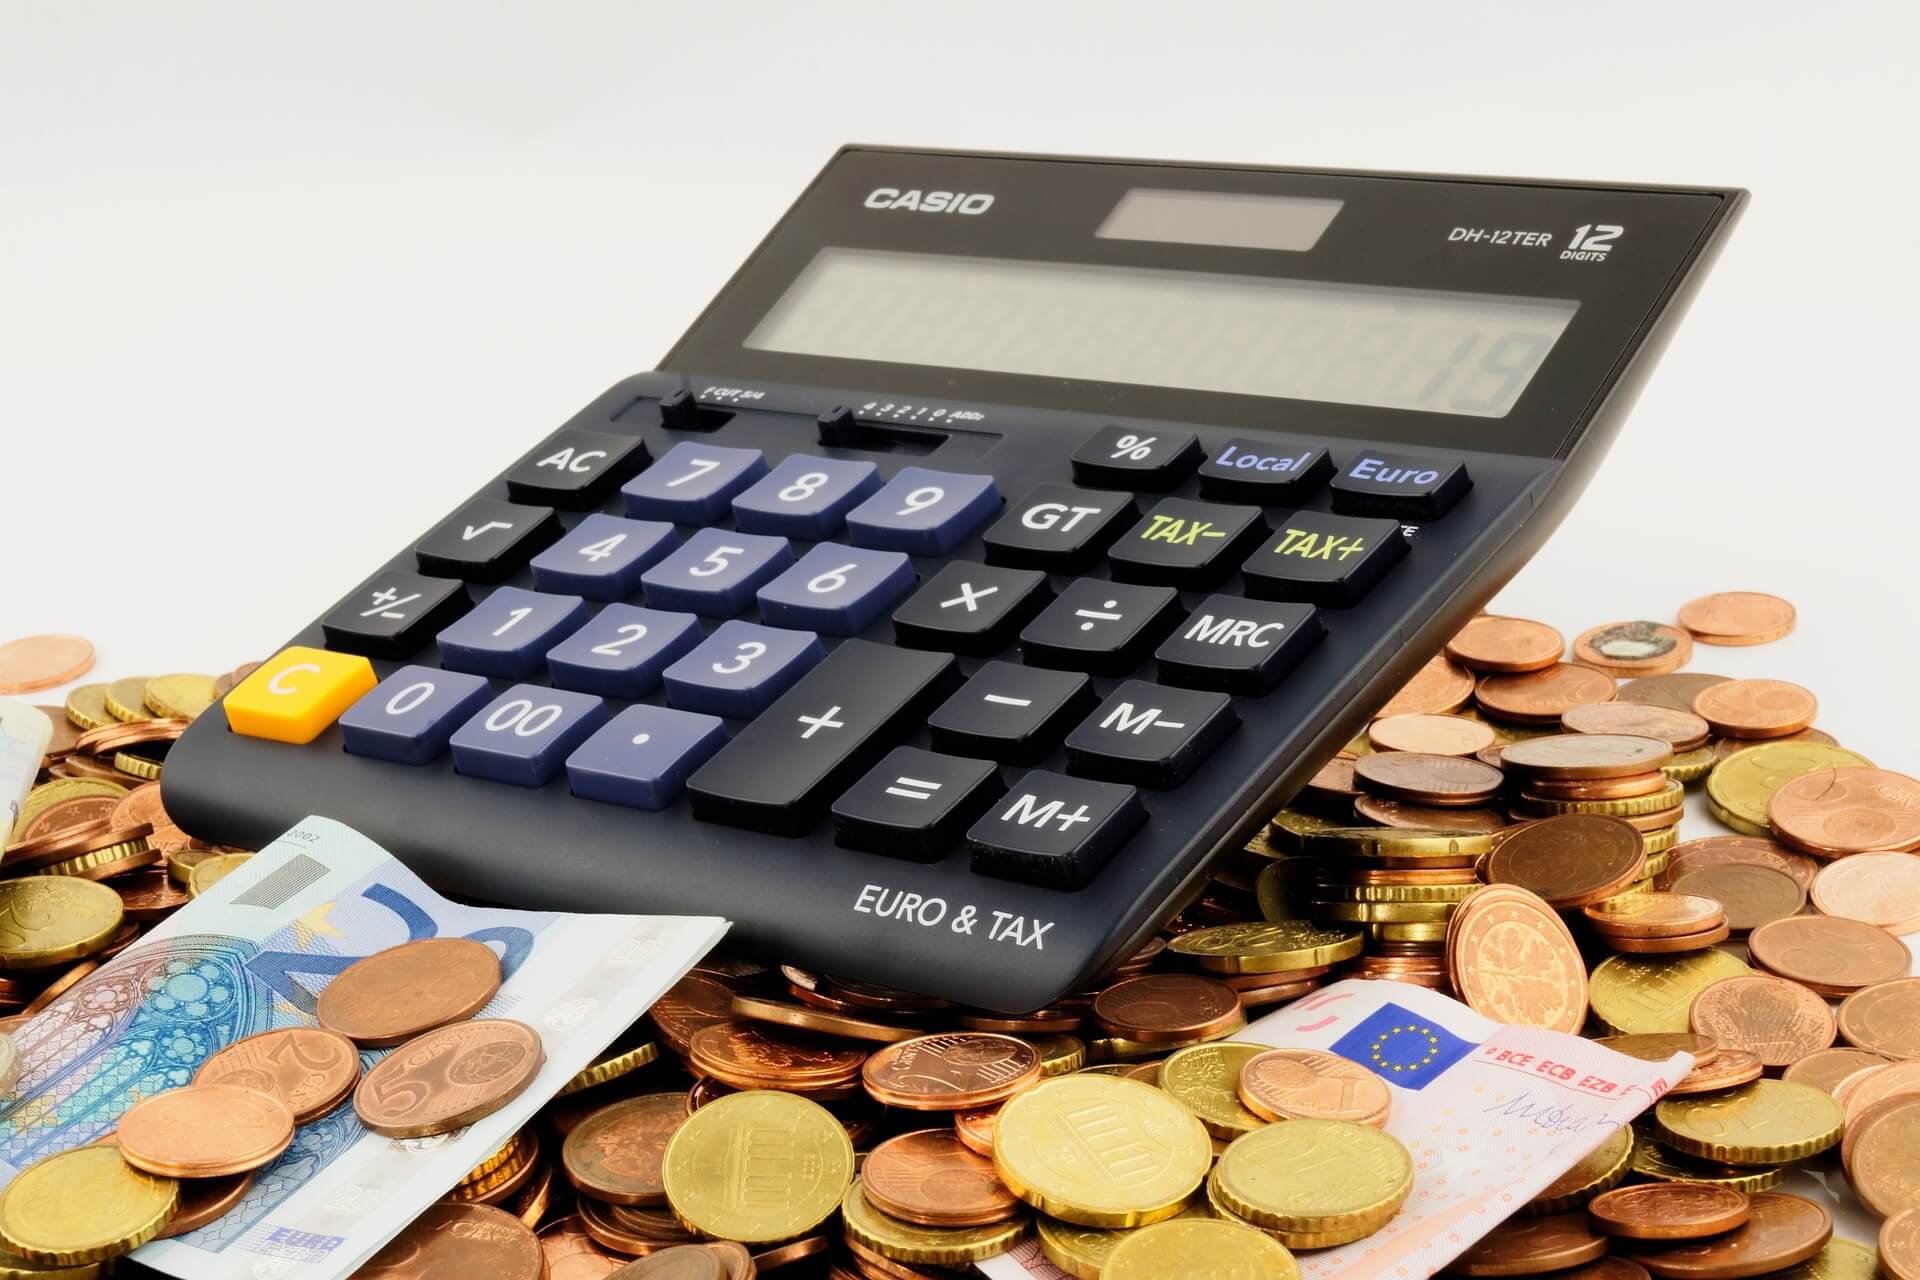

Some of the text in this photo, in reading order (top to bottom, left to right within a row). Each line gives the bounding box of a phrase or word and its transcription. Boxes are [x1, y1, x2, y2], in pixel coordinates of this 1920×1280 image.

[864, 188, 995, 215] CASIO
[1448, 227, 1553, 247] DH-12TER
[1567, 224, 1624, 252] 12
[1559, 250, 1608, 262] DIGITS
[932, 408, 947, 417] 0
[536, 447, 607, 473] AC
[1111, 435, 1157, 461] %
[1215, 446, 1310, 473] Local
[666, 459, 720, 487] 7
[1350, 457, 1440, 485] Euro
[778, 473, 829, 502] 8
[896, 486, 945, 516] 9
[1021, 503, 1102, 533] GT
[578, 533, 627, 563] 4
[1274, 528, 1364, 561] TAX+
[689, 546, 745, 577] 5
[807, 563, 857, 593] 6
[492, 607, 533, 637] 1
[1183, 614, 1285, 648] MRC
[591, 624, 648, 656] 2
[712, 641, 767, 674] 3
[267, 664, 321, 696] C
[385, 682, 435, 715] 0
[484, 699, 563, 737] 00
[1000, 794, 1091, 832] M+
[853, 884, 1055, 951] EURO & TAX
[1495, 1050, 1534, 1067] BCE
[1536, 1060, 1577, 1081] ECB
[1578, 1075, 1618, 1093] EZB
[372, 1063, 429, 1118] 5
